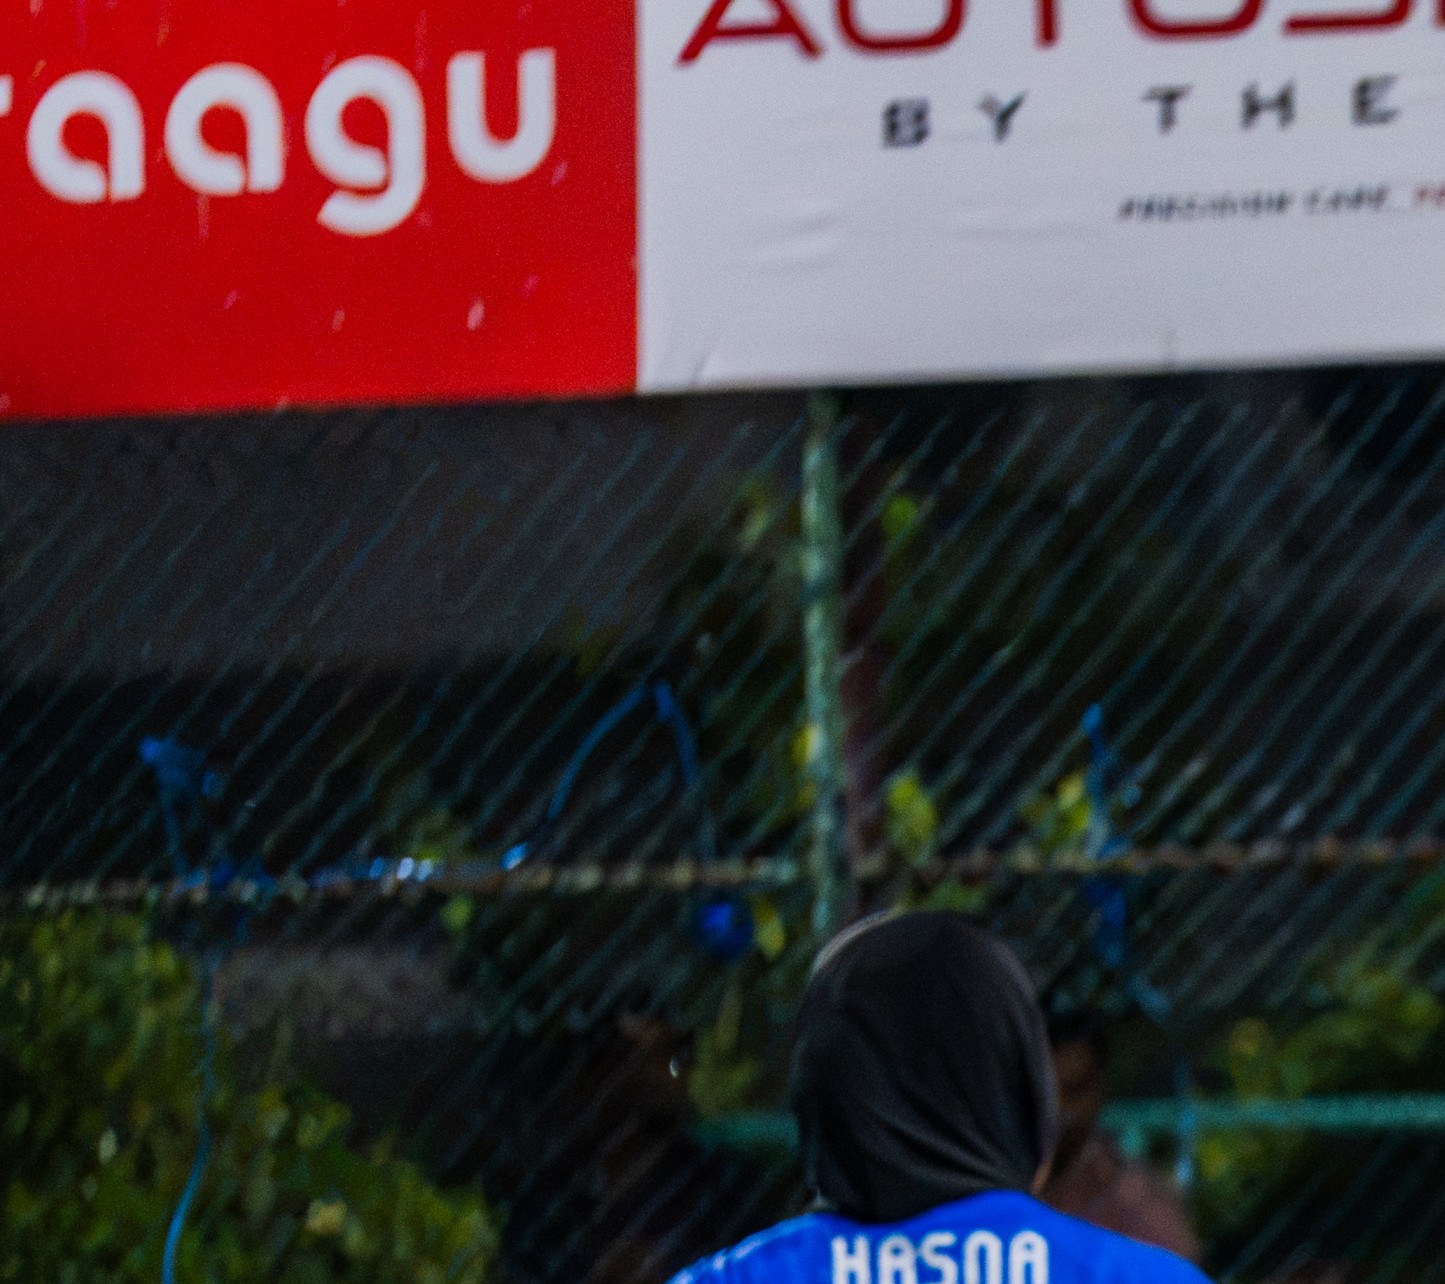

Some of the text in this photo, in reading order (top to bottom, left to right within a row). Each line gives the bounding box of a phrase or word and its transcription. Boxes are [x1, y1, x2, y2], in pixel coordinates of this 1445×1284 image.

[0, 48, 556, 236] aagu
[881, 95, 1026, 148] BY
[1143, 74, 1400, 133] THE
